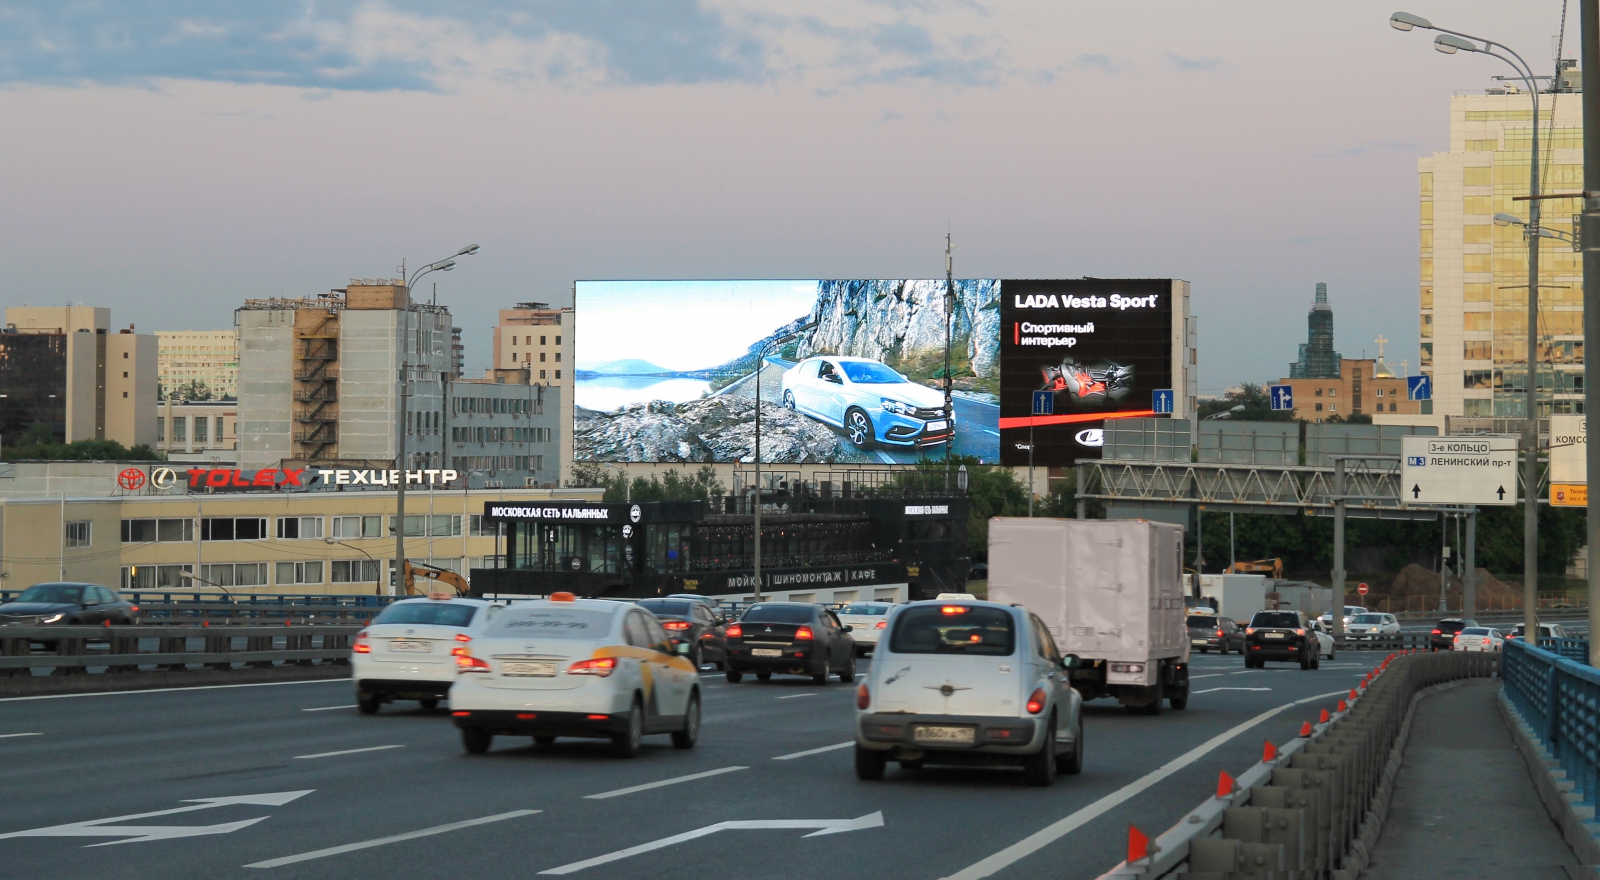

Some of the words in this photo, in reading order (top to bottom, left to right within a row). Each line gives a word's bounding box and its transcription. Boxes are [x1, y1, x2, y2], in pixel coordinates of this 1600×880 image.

[1014, 294, 1060, 309] LADA
[1061, 294, 1107, 309] Vesta
[1021, 322, 1095, 336] Спортивный
[1021, 336, 1077, 348] интерьер
[1431, 443, 1445, 452] 3-е
[1447, 443, 1488, 454] КОЛЬЦО
[1430, 457, 1490, 467] ЛЕНИНСКИЙ
[1492, 460, 1512, 468] пр-т
[187, 468, 304, 487] TOLEX
[318, 469, 458, 486] ТЕХЦЕНТР
[491, 506, 541, 518] МОСКОВСКАЯ
[542, 508, 561, 519] СЕТЬ
[562, 508, 609, 519] КАЛЬЯННЫХ
[772, 571, 842, 585] ШИНОМОНТАЖ
[851, 569, 876, 580] КАФЕ
